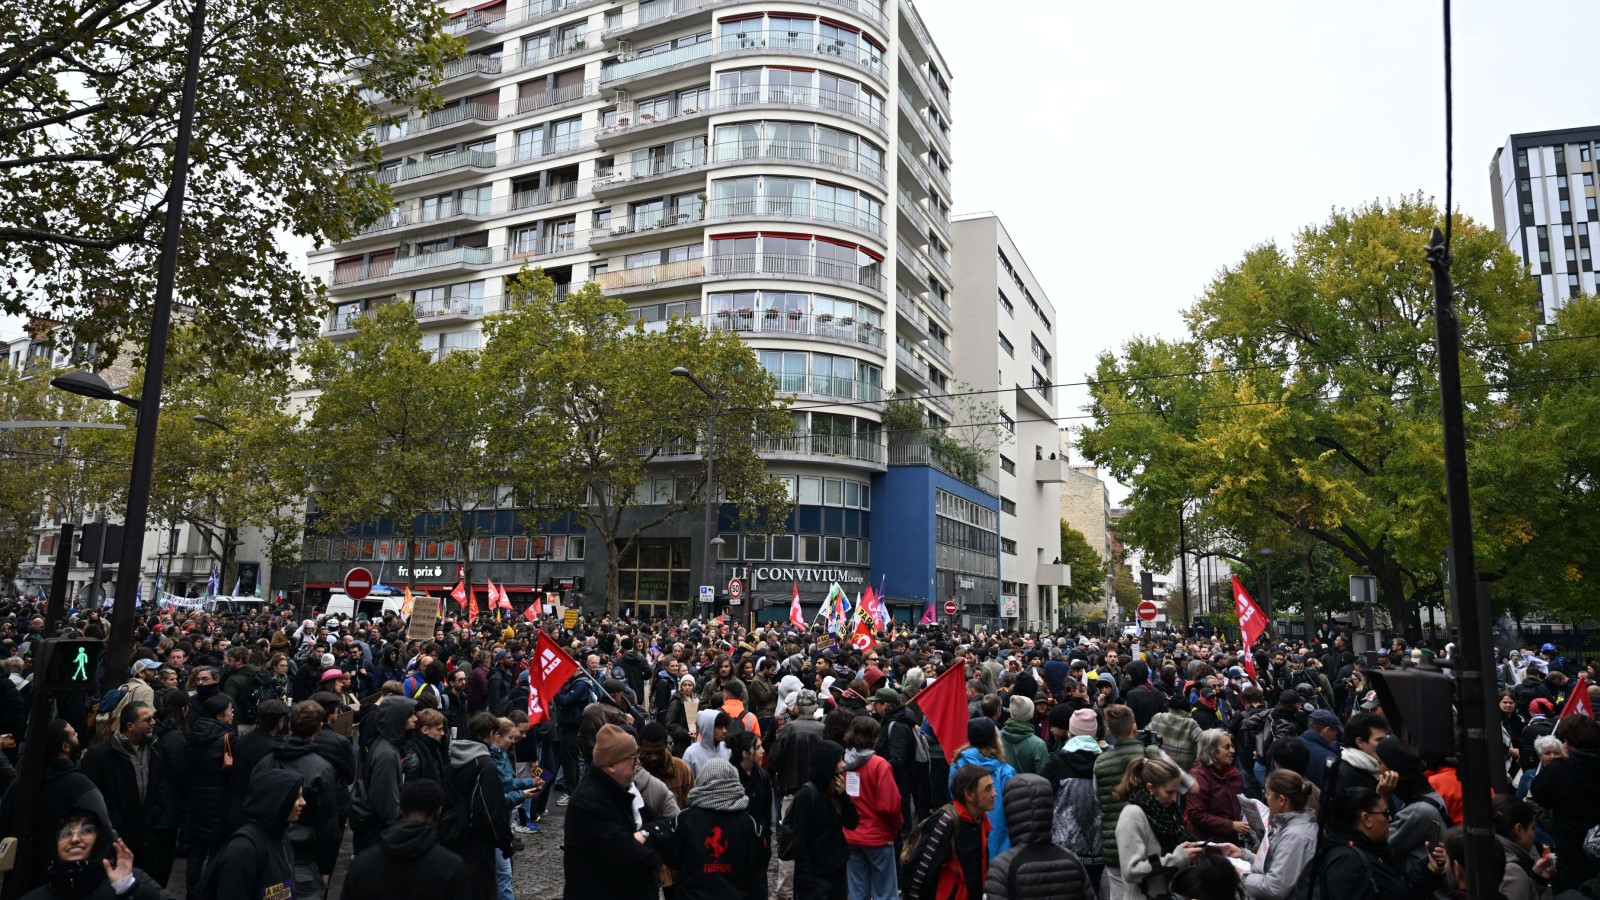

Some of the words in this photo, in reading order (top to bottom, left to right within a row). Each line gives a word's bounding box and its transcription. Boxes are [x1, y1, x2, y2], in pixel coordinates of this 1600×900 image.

[398, 566, 433, 578] fraprix
[757, 567, 849, 583] CONVIVIUM
[732, 584, 740, 593] 50
